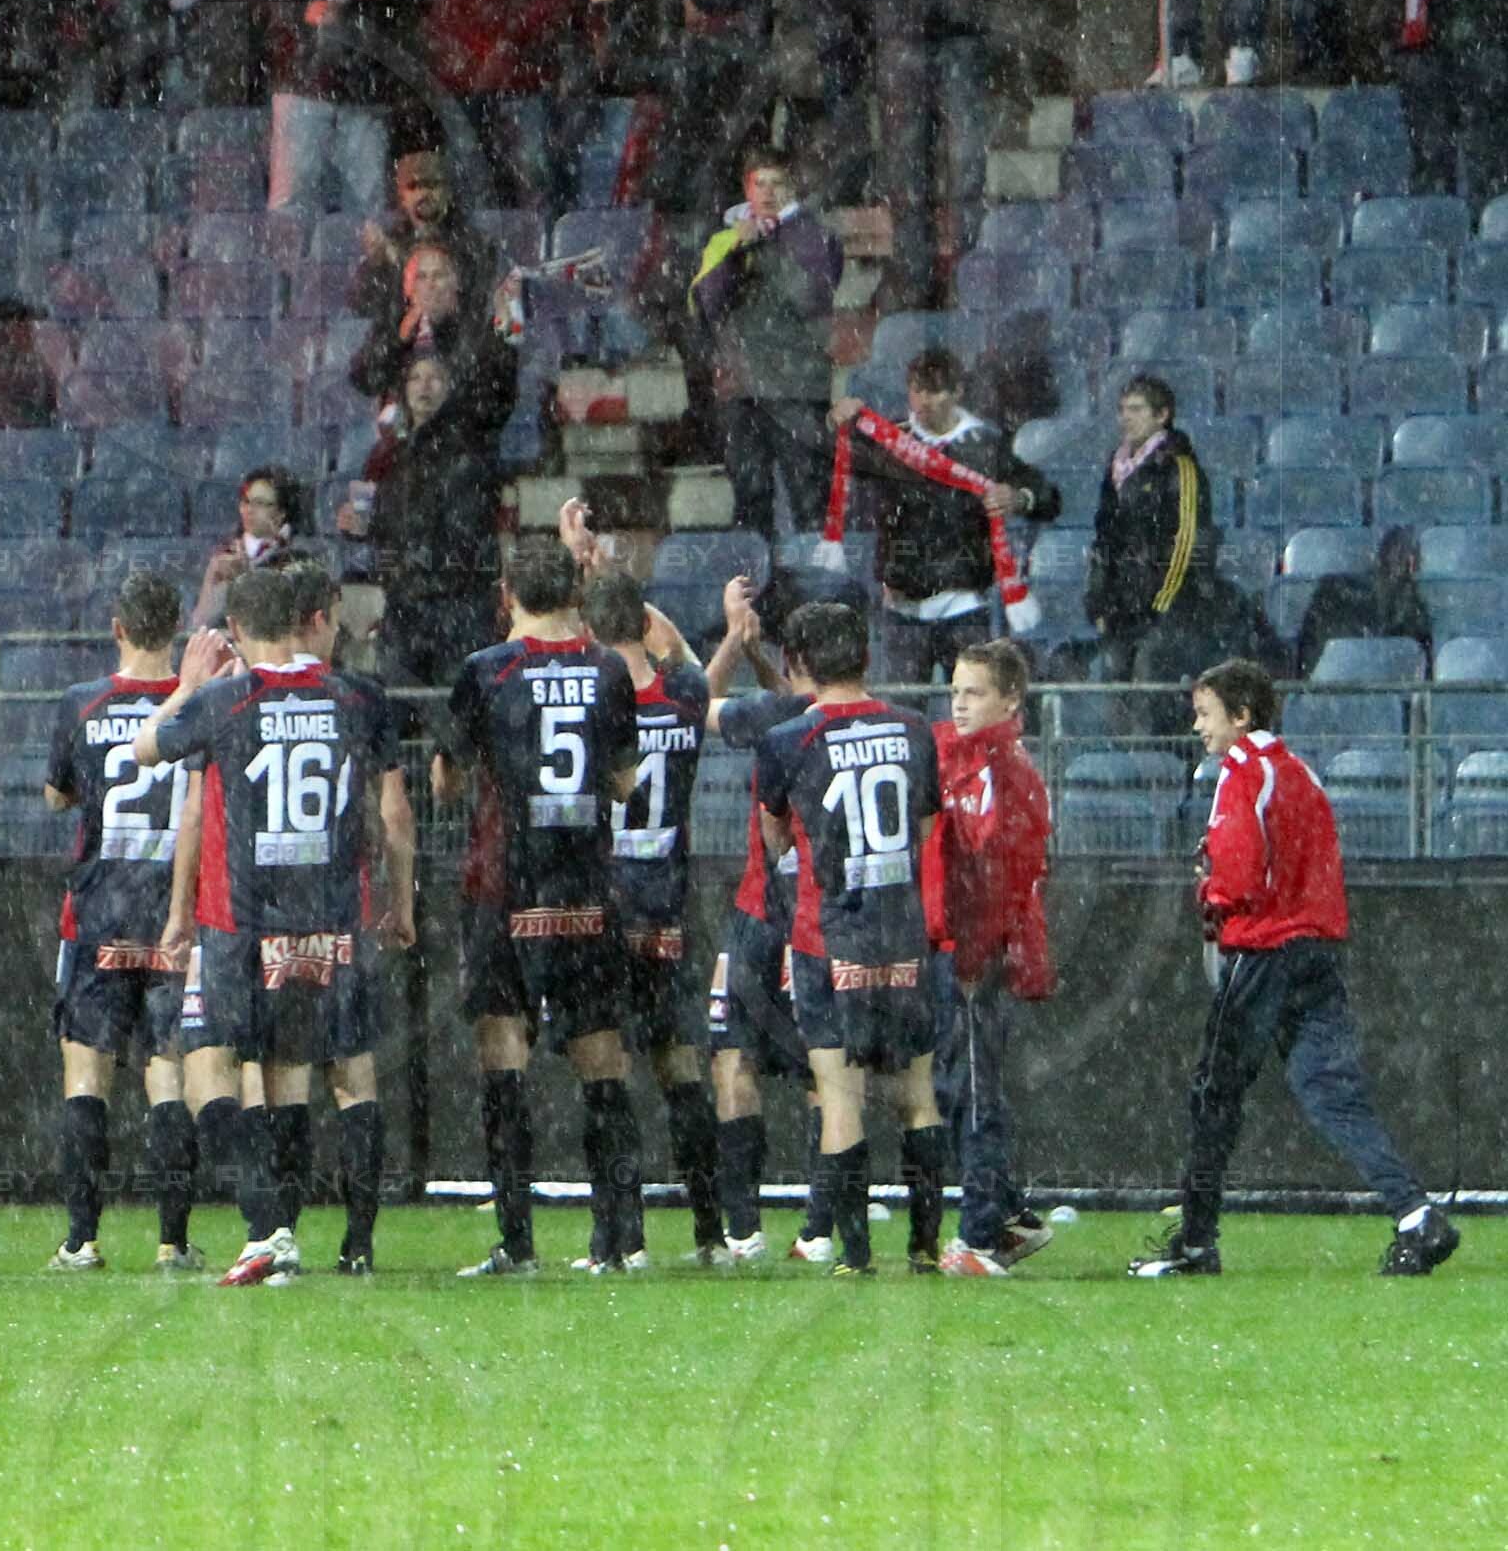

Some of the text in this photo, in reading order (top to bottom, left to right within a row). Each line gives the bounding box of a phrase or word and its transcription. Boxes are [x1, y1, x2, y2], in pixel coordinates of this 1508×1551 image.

[531, 679, 596, 704] SARE
[86, 718, 146, 745] RADA
[539, 707, 586, 793] 5
[828, 737, 910, 770] RAUTER
[103, 744, 188, 829] 21
[245, 742, 332, 832] 16
[822, 764, 909, 856] 10
[511, 916, 604, 938] ZEITUNG
